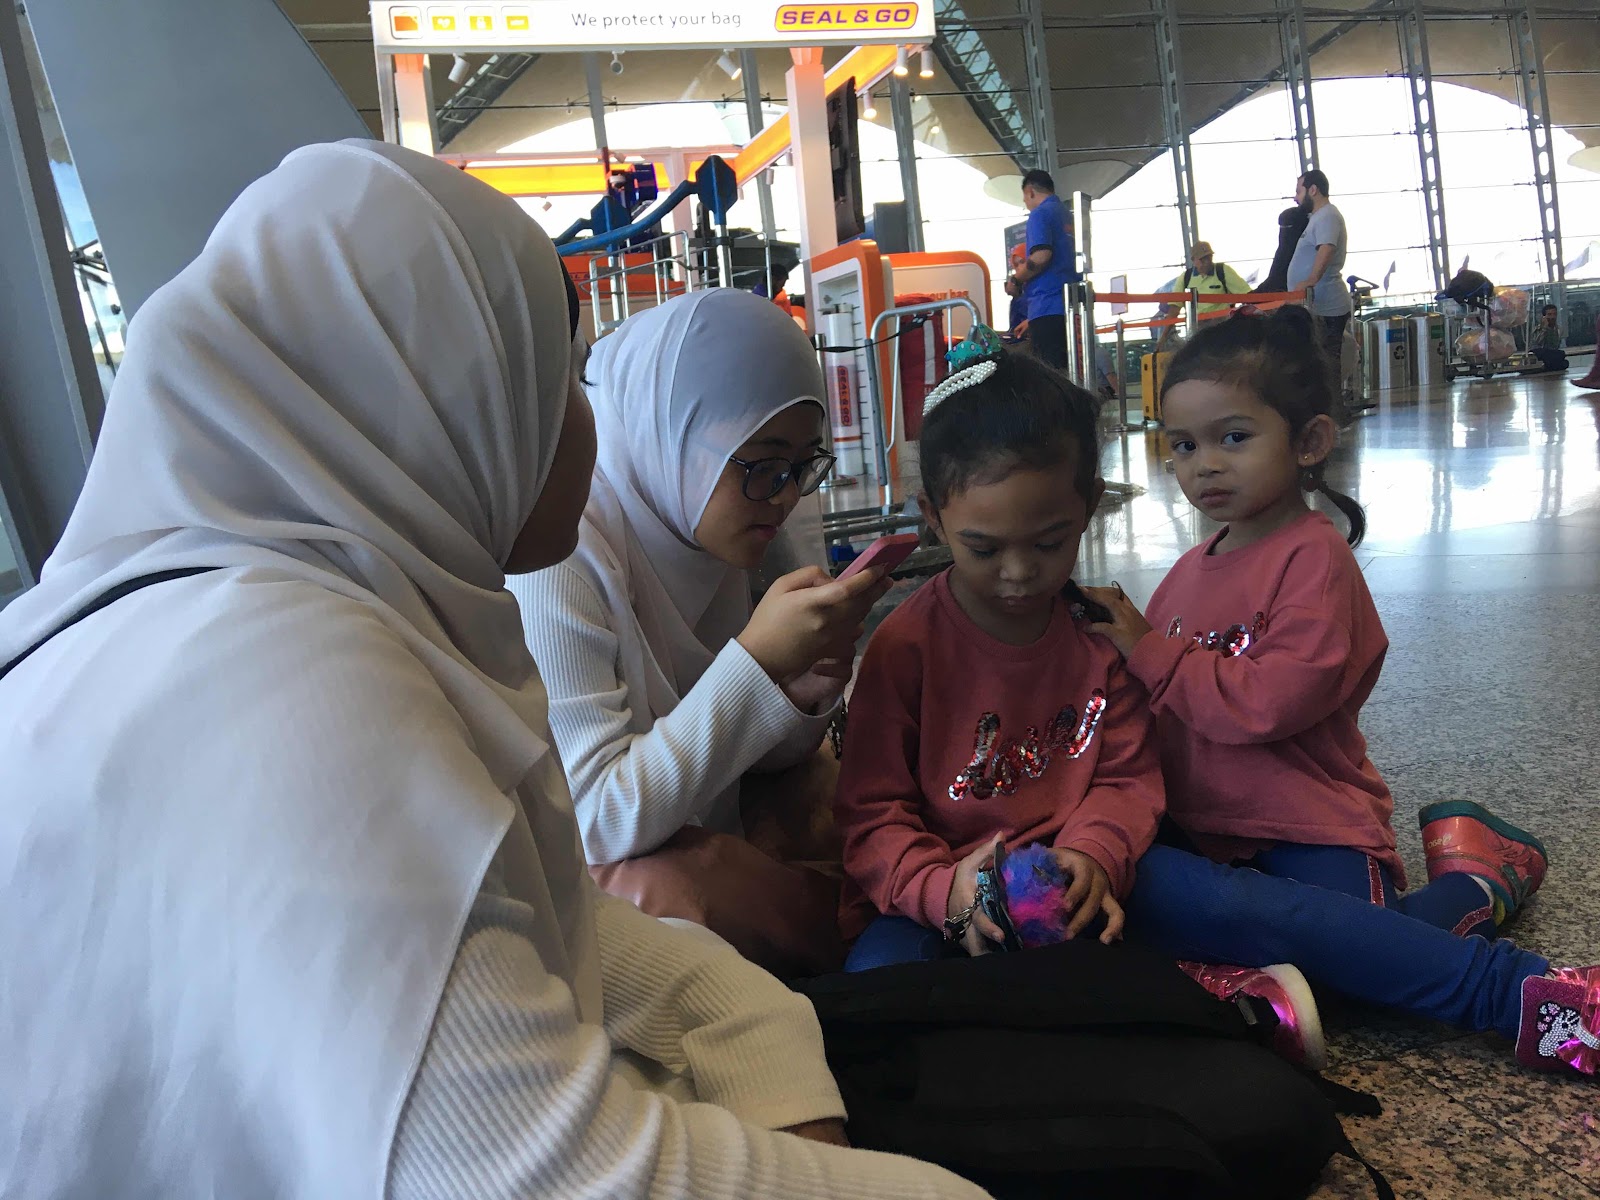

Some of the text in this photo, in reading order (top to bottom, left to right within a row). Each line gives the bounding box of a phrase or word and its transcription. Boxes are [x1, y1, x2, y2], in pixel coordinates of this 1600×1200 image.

[571, 11, 741, 29] We protect your bag
[782, 9, 910, 25] SEAL & GO
